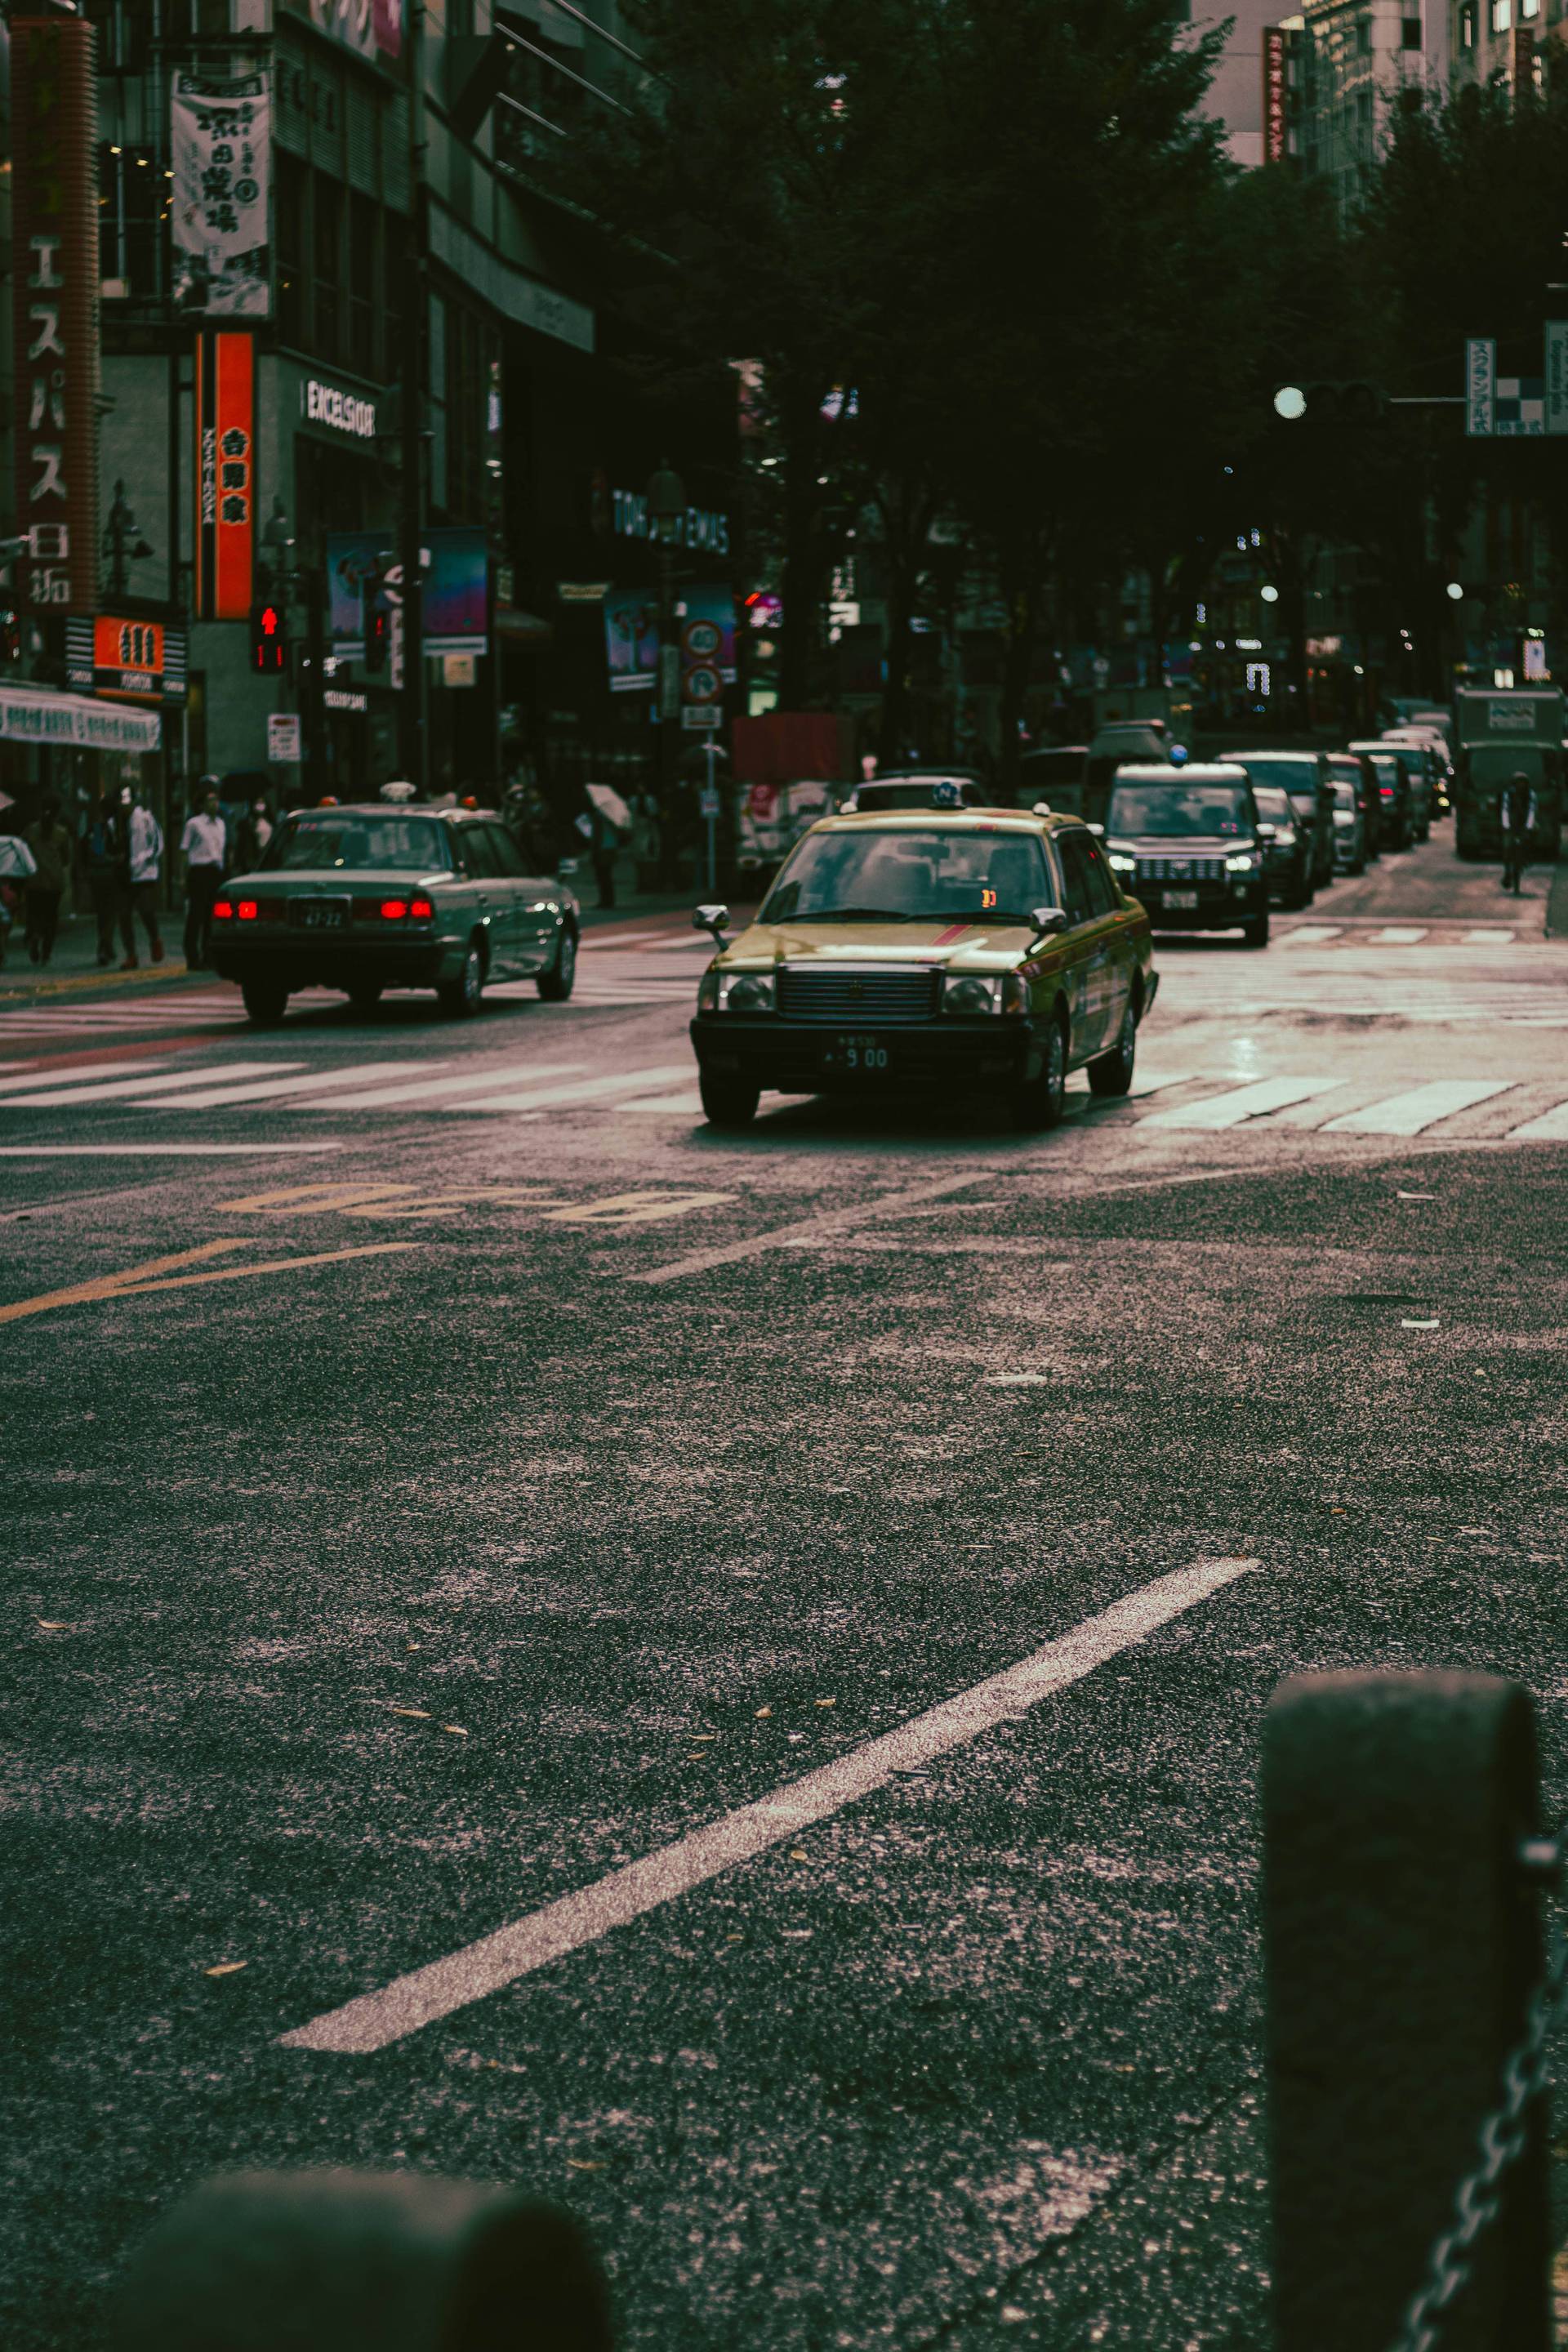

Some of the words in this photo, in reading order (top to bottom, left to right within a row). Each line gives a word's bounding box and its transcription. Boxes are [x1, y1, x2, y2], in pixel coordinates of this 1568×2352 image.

[29, 236, 71, 604] エスパス日拓
[307, 380, 376, 438] EXCELSIOR
[690, 630, 715, 648] 40
